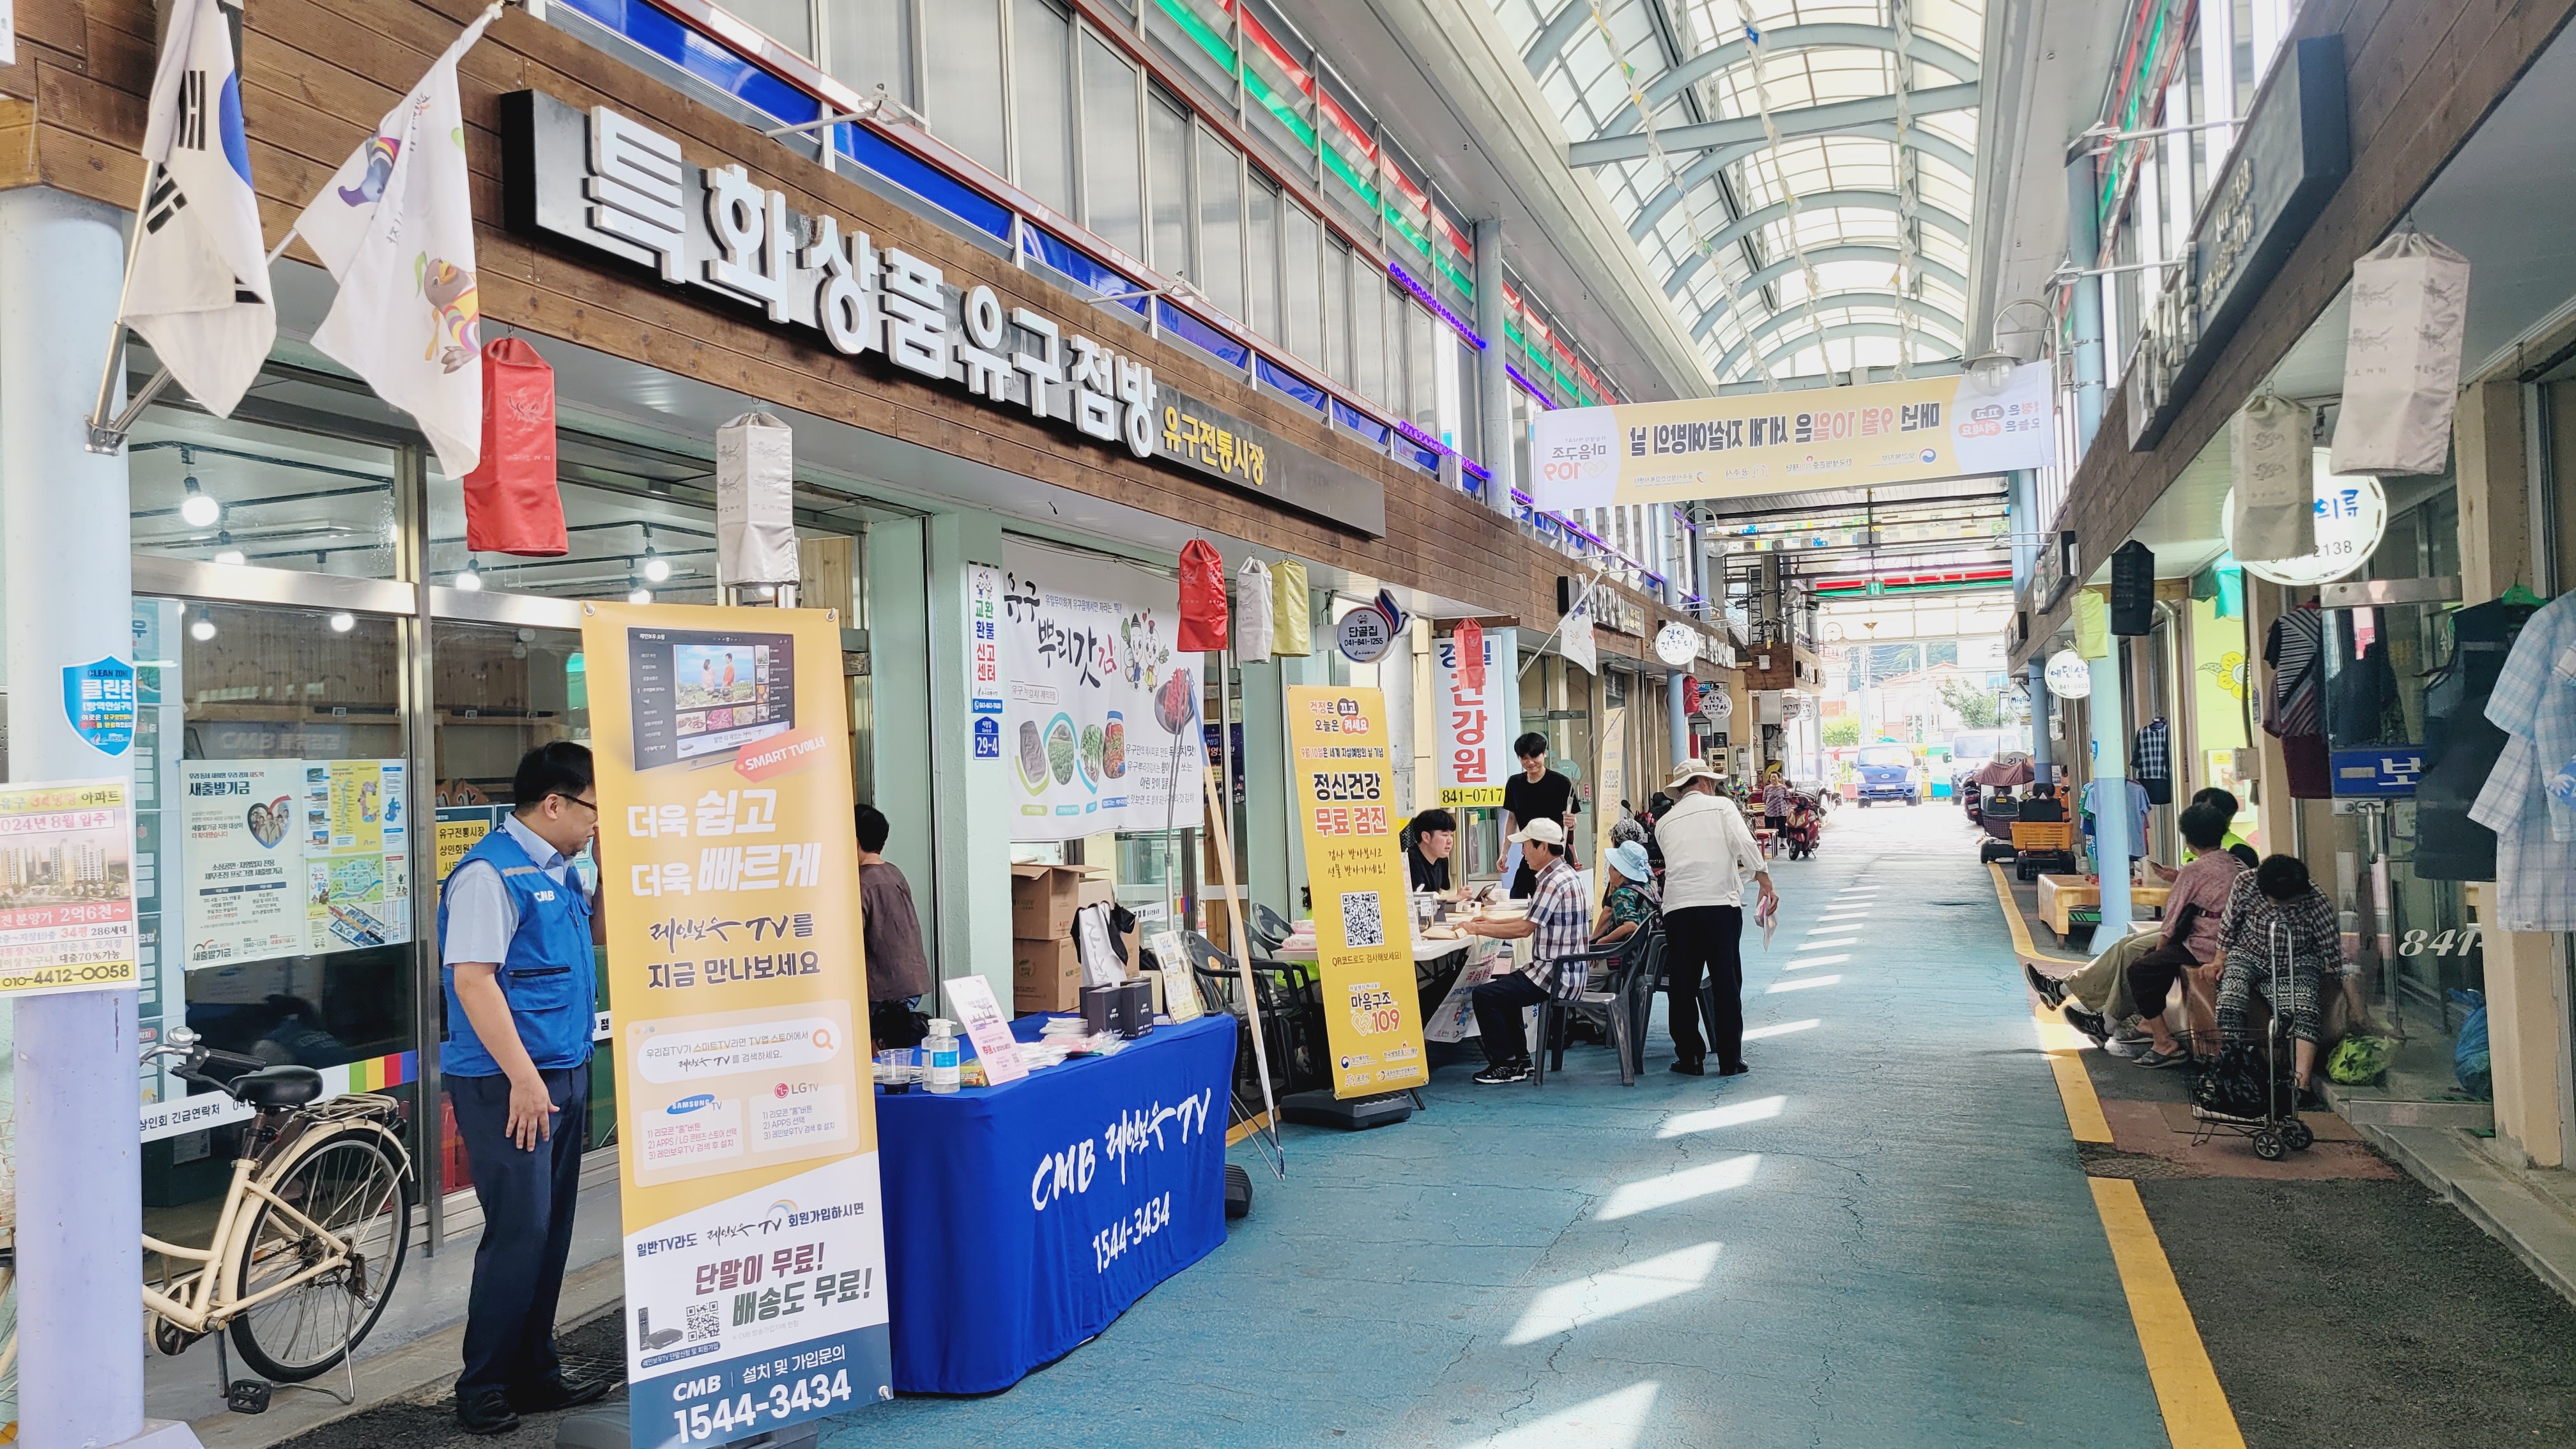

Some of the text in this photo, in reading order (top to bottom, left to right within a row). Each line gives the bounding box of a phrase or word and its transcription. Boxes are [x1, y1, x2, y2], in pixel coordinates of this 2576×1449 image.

[1162, 406, 1265, 486] 유구전통시장
[1004, 572, 1040, 624] 유구
[975, 599, 993, 619] 교환
[1349, 625, 1377, 638] 단골집
[1666, 629, 1686, 639] 경일
[1345, 638, 1383, 647] 041-841-1255
[977, 643, 995, 662] 신고
[1038, 617, 1121, 689] 뿌리갓김
[977, 664, 995, 682] 센터
[2050, 665, 2090, 678] 에덴상
[81, 679, 132, 700] 클린존
[1310, 702, 1357, 714] 걱정은 끄고
[1315, 719, 1368, 732] 오늘은 켜세요
[977, 737, 998, 755] 29-4
[1301, 747, 1310, 758] 9월
[1311, 747, 1328, 758] 10일은
[1342, 747, 1367, 758] 자살예방의
[1368, 747, 1373, 758] 날
[1374, 747, 1384, 758] 기념
[745, 749, 786, 771] SMART
[188, 781, 250, 796] 새출발기금
[1314, 773, 1381, 801] 정신건강
[81, 791, 121, 804] 아파트
[1442, 788, 1503, 804] 841-0717
[51, 813, 107, 829] 8월 입주
[627, 788, 778, 839] 더욱 쉽고
[1315, 806, 1388, 836] 무료 검진
[439, 826, 484, 839] 유구전통시장
[1328, 847, 1383, 861] 검사 받아보시고
[631, 843, 822, 898] 더욱 빠르게
[1328, 862, 1386, 878] 선물 받아가세요!
[534, 891, 555, 902] CMB
[16, 911, 53, 926] 분양가
[91, 925, 127, 935] 286세대
[193, 948, 231, 961] 새출발기금
[1332, 951, 1402, 967] QR코드로도 검사해보세요!
[3, 964, 130, 987] 010-4412-0058
[647, 951, 821, 990] 지금 만나보세요
[1351, 992, 1392, 1011] 마음구조
[1372, 1009, 1400, 1032] 109
[647, 1031, 809, 1058] 우리집TV가 스마트TV라면 TV앱 스토어에서
[742, 1050, 783, 1063] 검색하세요.
[791, 1082, 819, 1094] LG TV
[172, 1103, 220, 1124] 긴급연락처
[671, 1099, 723, 1111] SAMSUNG TV
[770, 1108, 788, 1118] 리모콘
[772, 1118, 791, 1128] APPS
[655, 1126, 675, 1138] 리모콘
[656, 1137, 674, 1147] APPS
[1032, 1138, 1096, 1211] CMB
[637, 1232, 698, 1257] 일반TV라도
[788, 1202, 864, 1227] 회원가입하시면
[1092, 1191, 1170, 1274] 1544-3434
[696, 1242, 825, 1296] 단말이 무료!
[732, 1268, 872, 1327] 배송도 무료!
[673, 1344, 846, 1402] CMB 설치 및 가입문의
[673, 1368, 852, 1444] 1544-3434
